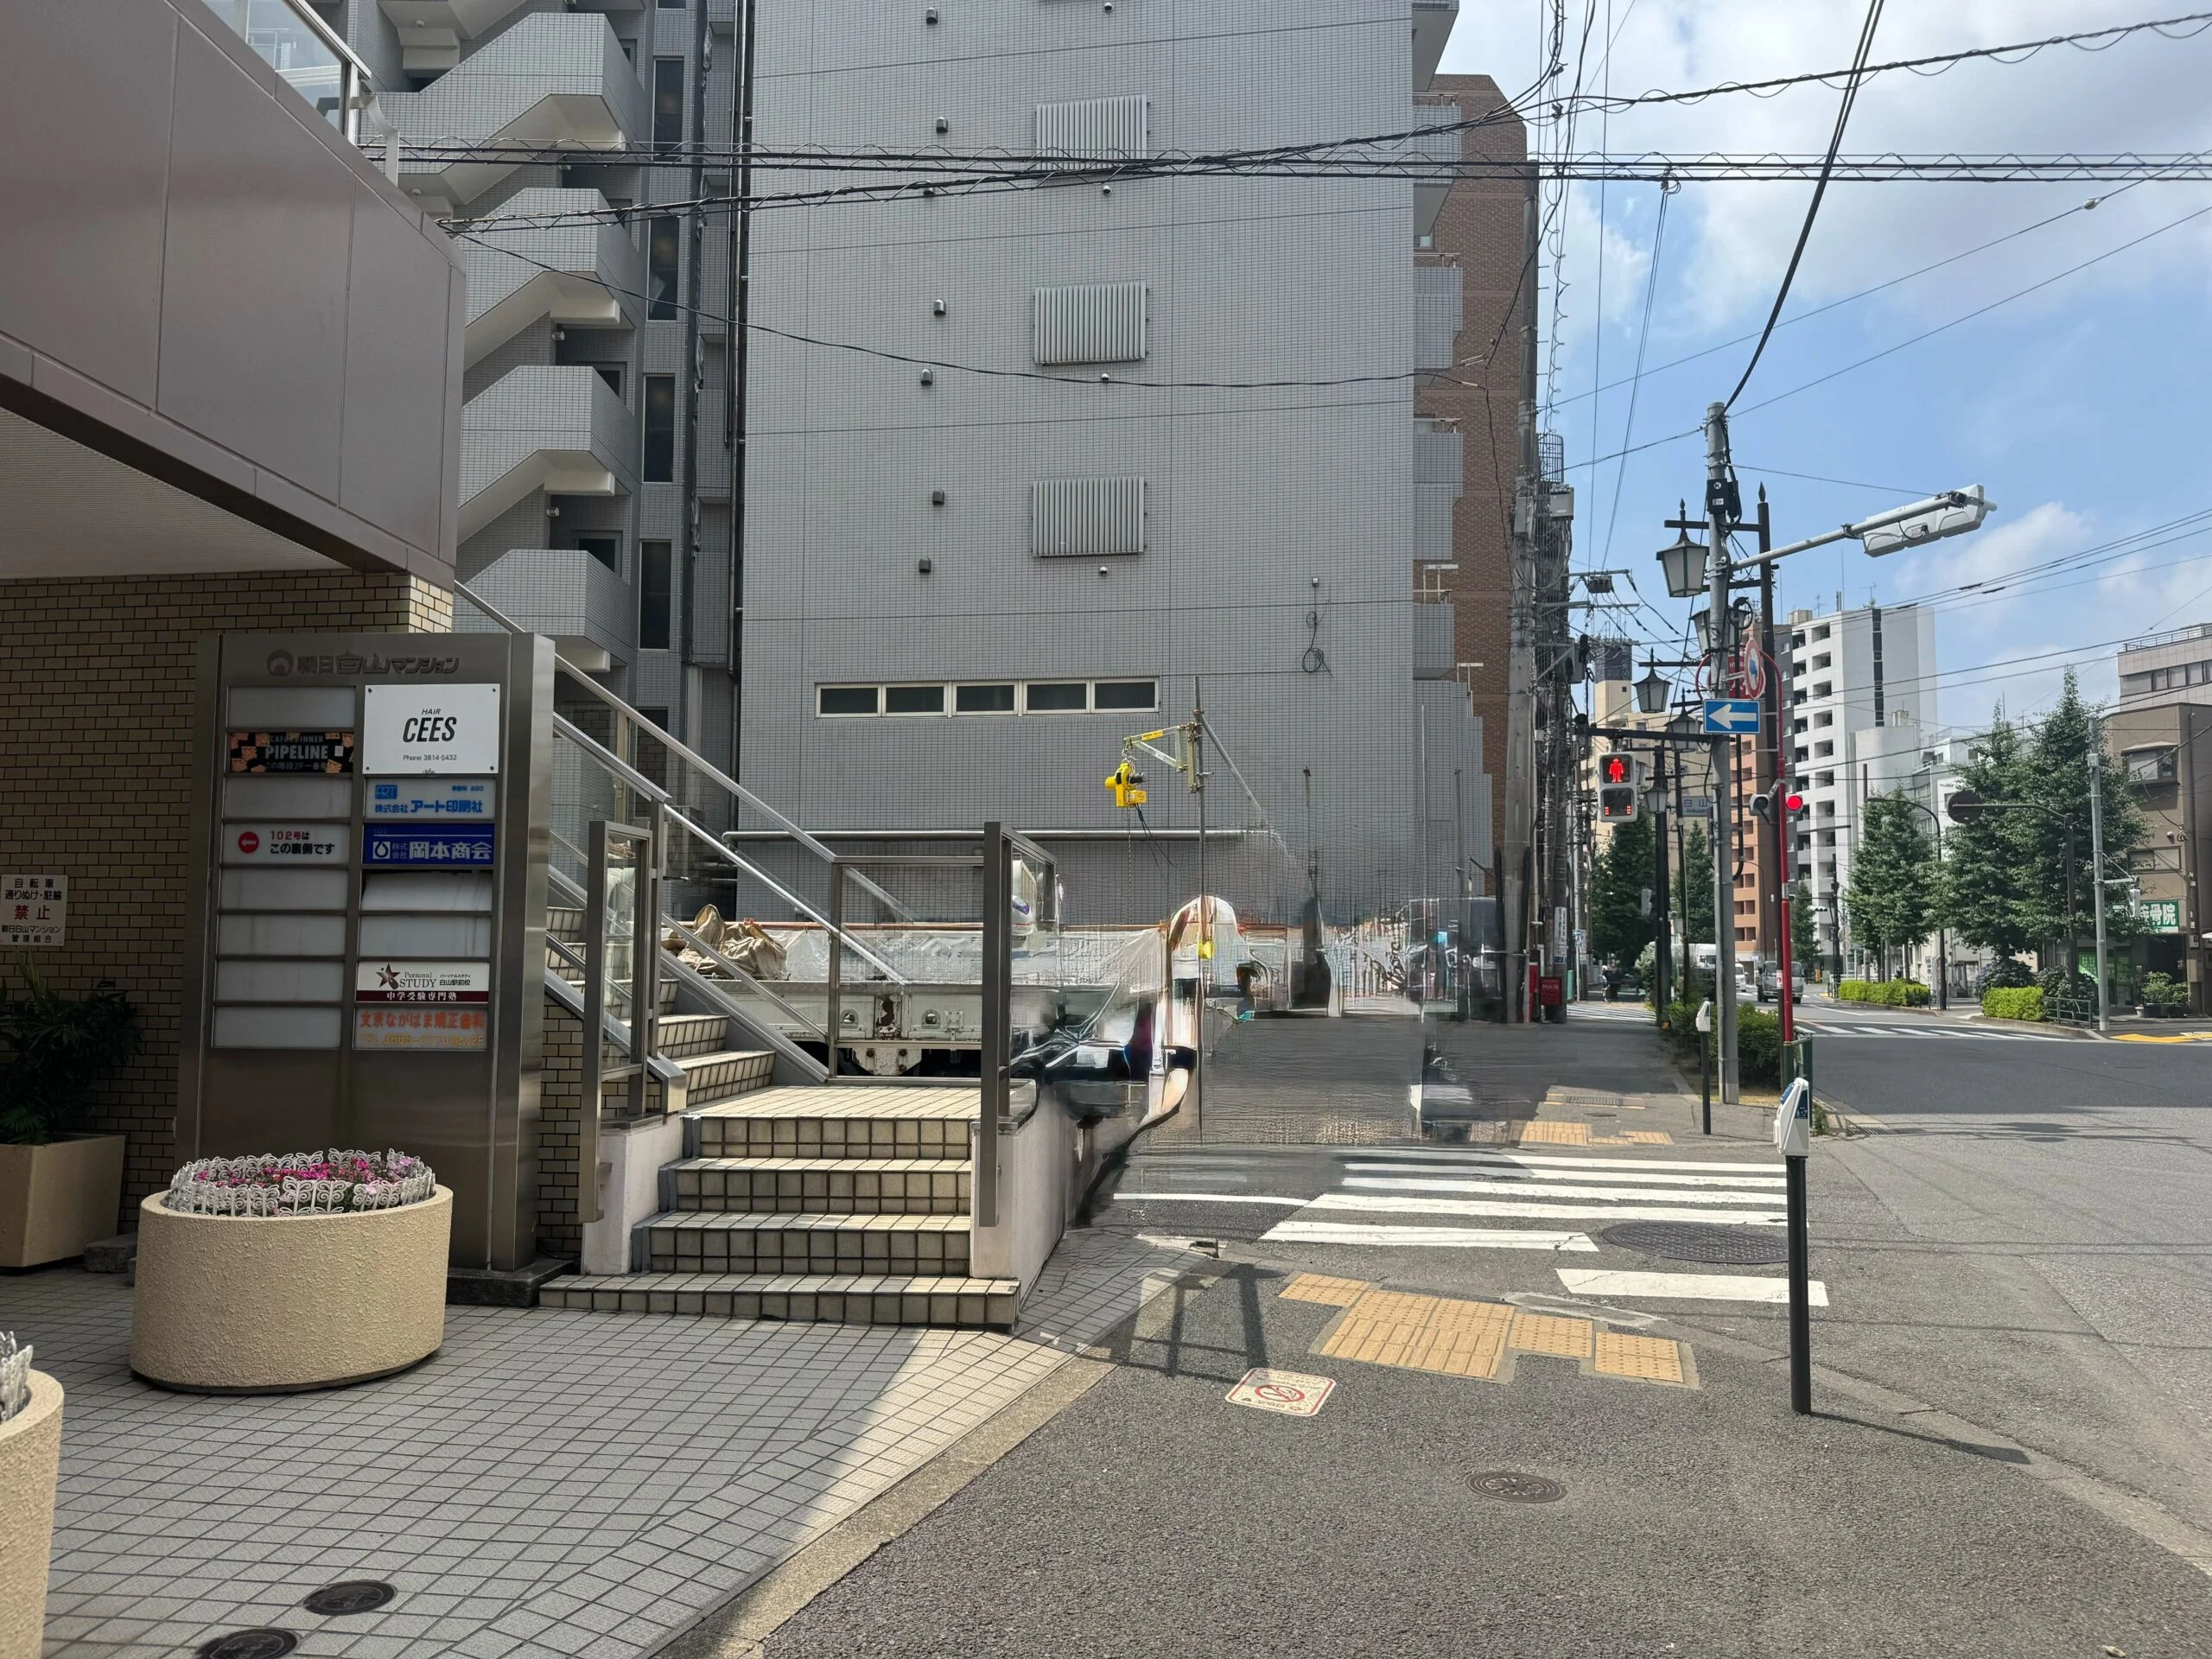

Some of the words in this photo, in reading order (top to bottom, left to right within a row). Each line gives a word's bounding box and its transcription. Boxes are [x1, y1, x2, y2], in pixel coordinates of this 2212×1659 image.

[403, 716, 457, 743] CEES
[265, 745, 328, 760] PIPELINE
[270, 830, 310, 840] 102号は
[270, 842, 335, 854] この裏側です
[409, 841, 493, 860] 岡本商会
[15, 878, 54, 888] 自転車
[15, 905, 50, 920] 禁止
[399, 978, 437, 988] STUDY
[386, 991, 457, 1001] 中学受験専門塾
